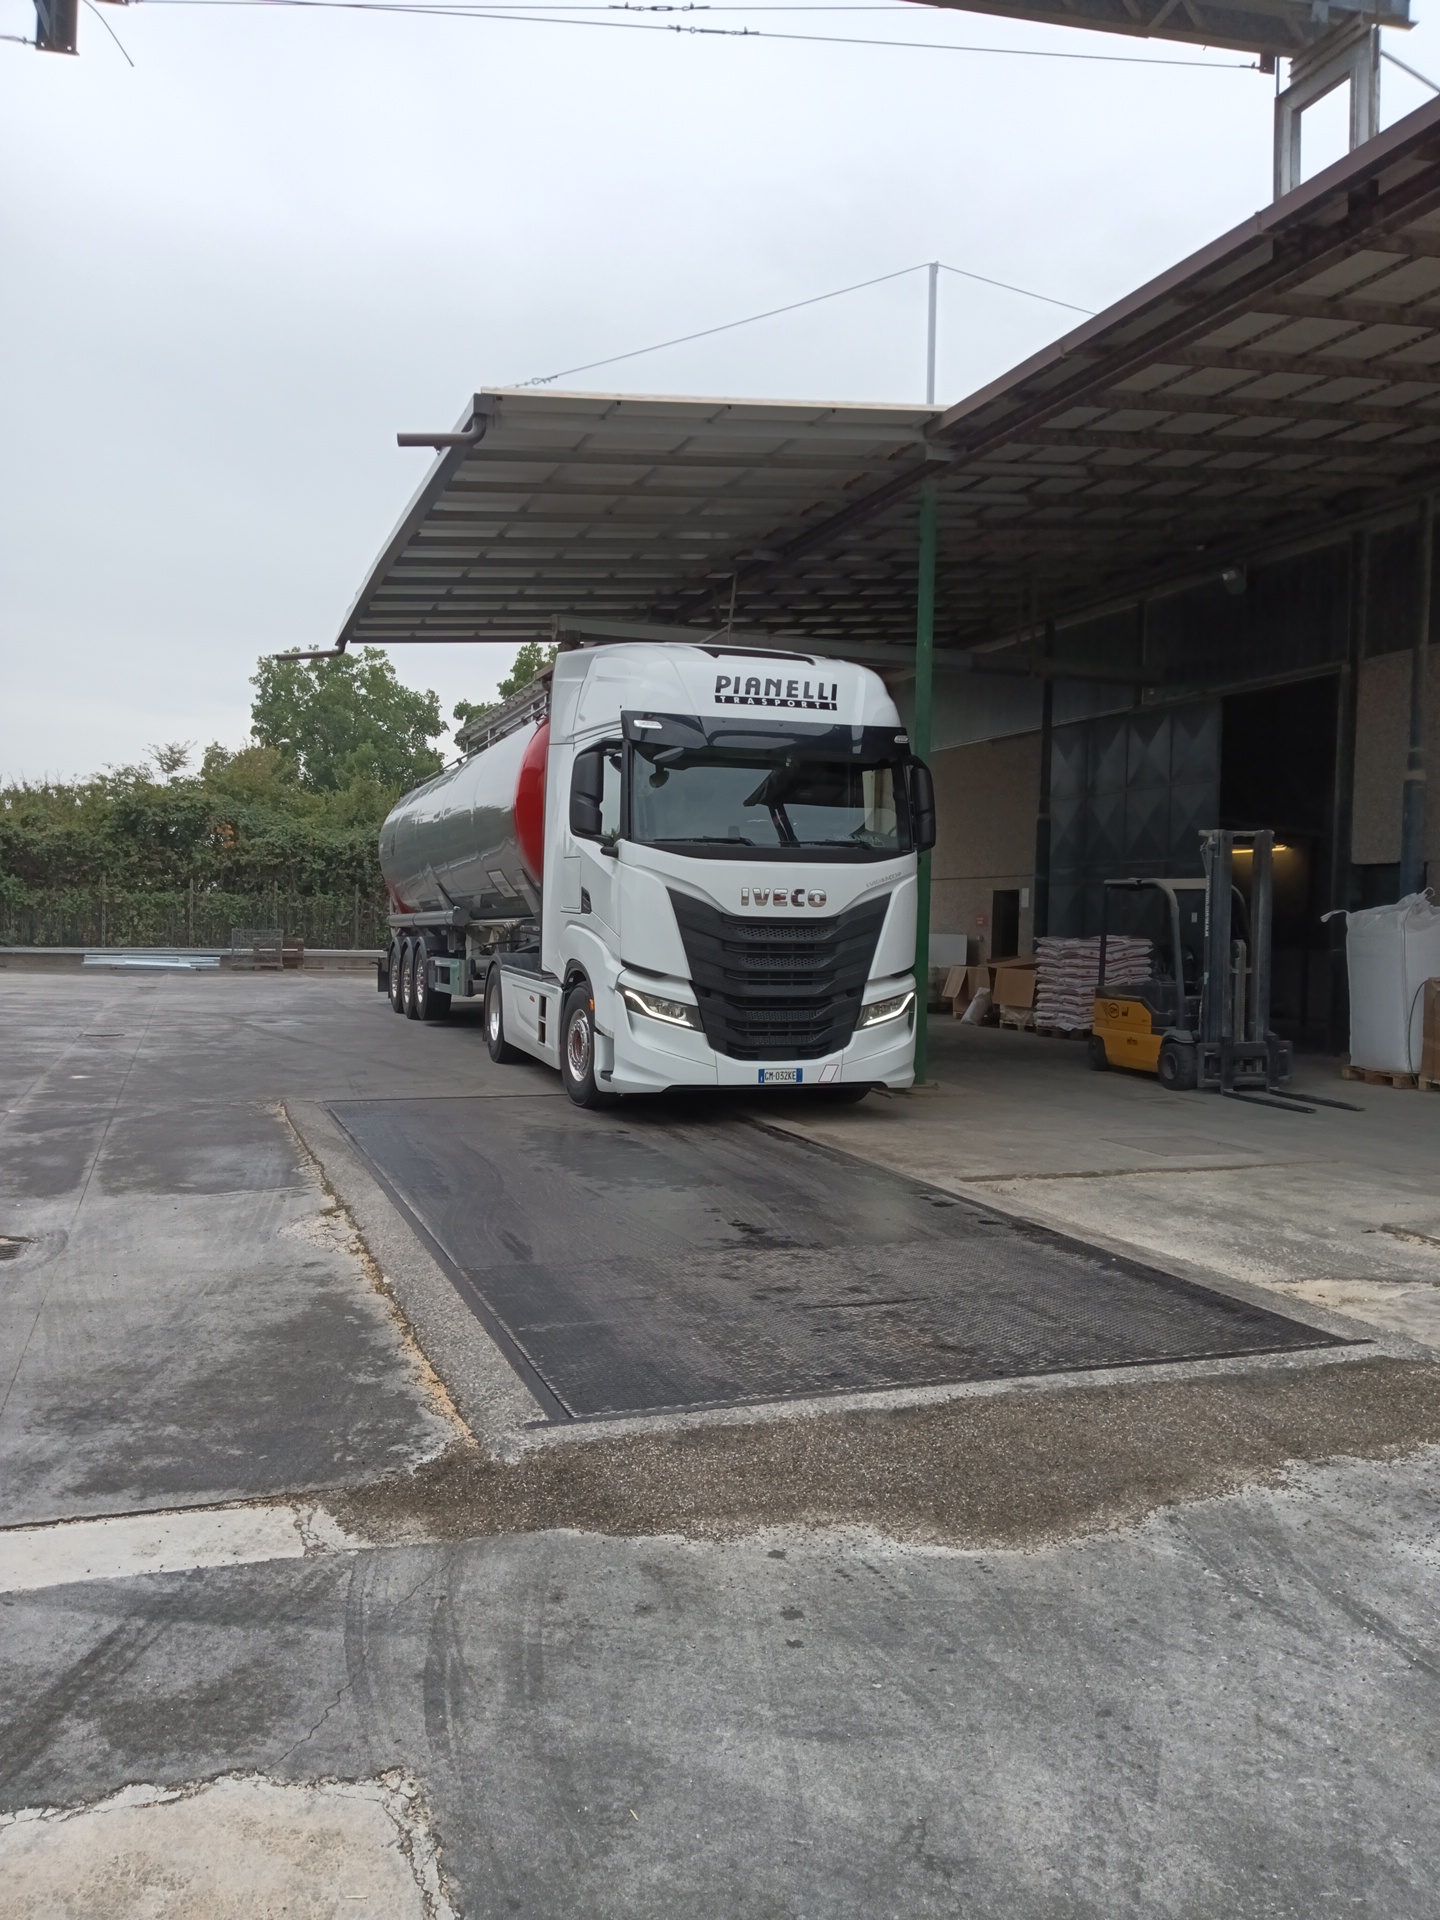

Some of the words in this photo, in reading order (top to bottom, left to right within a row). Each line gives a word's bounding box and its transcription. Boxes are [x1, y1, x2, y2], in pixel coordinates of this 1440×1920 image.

[715, 675, 838, 701] PIANELLI
[719, 696, 834, 710] TRASPORTI
[740, 887, 827, 908] IVECO
